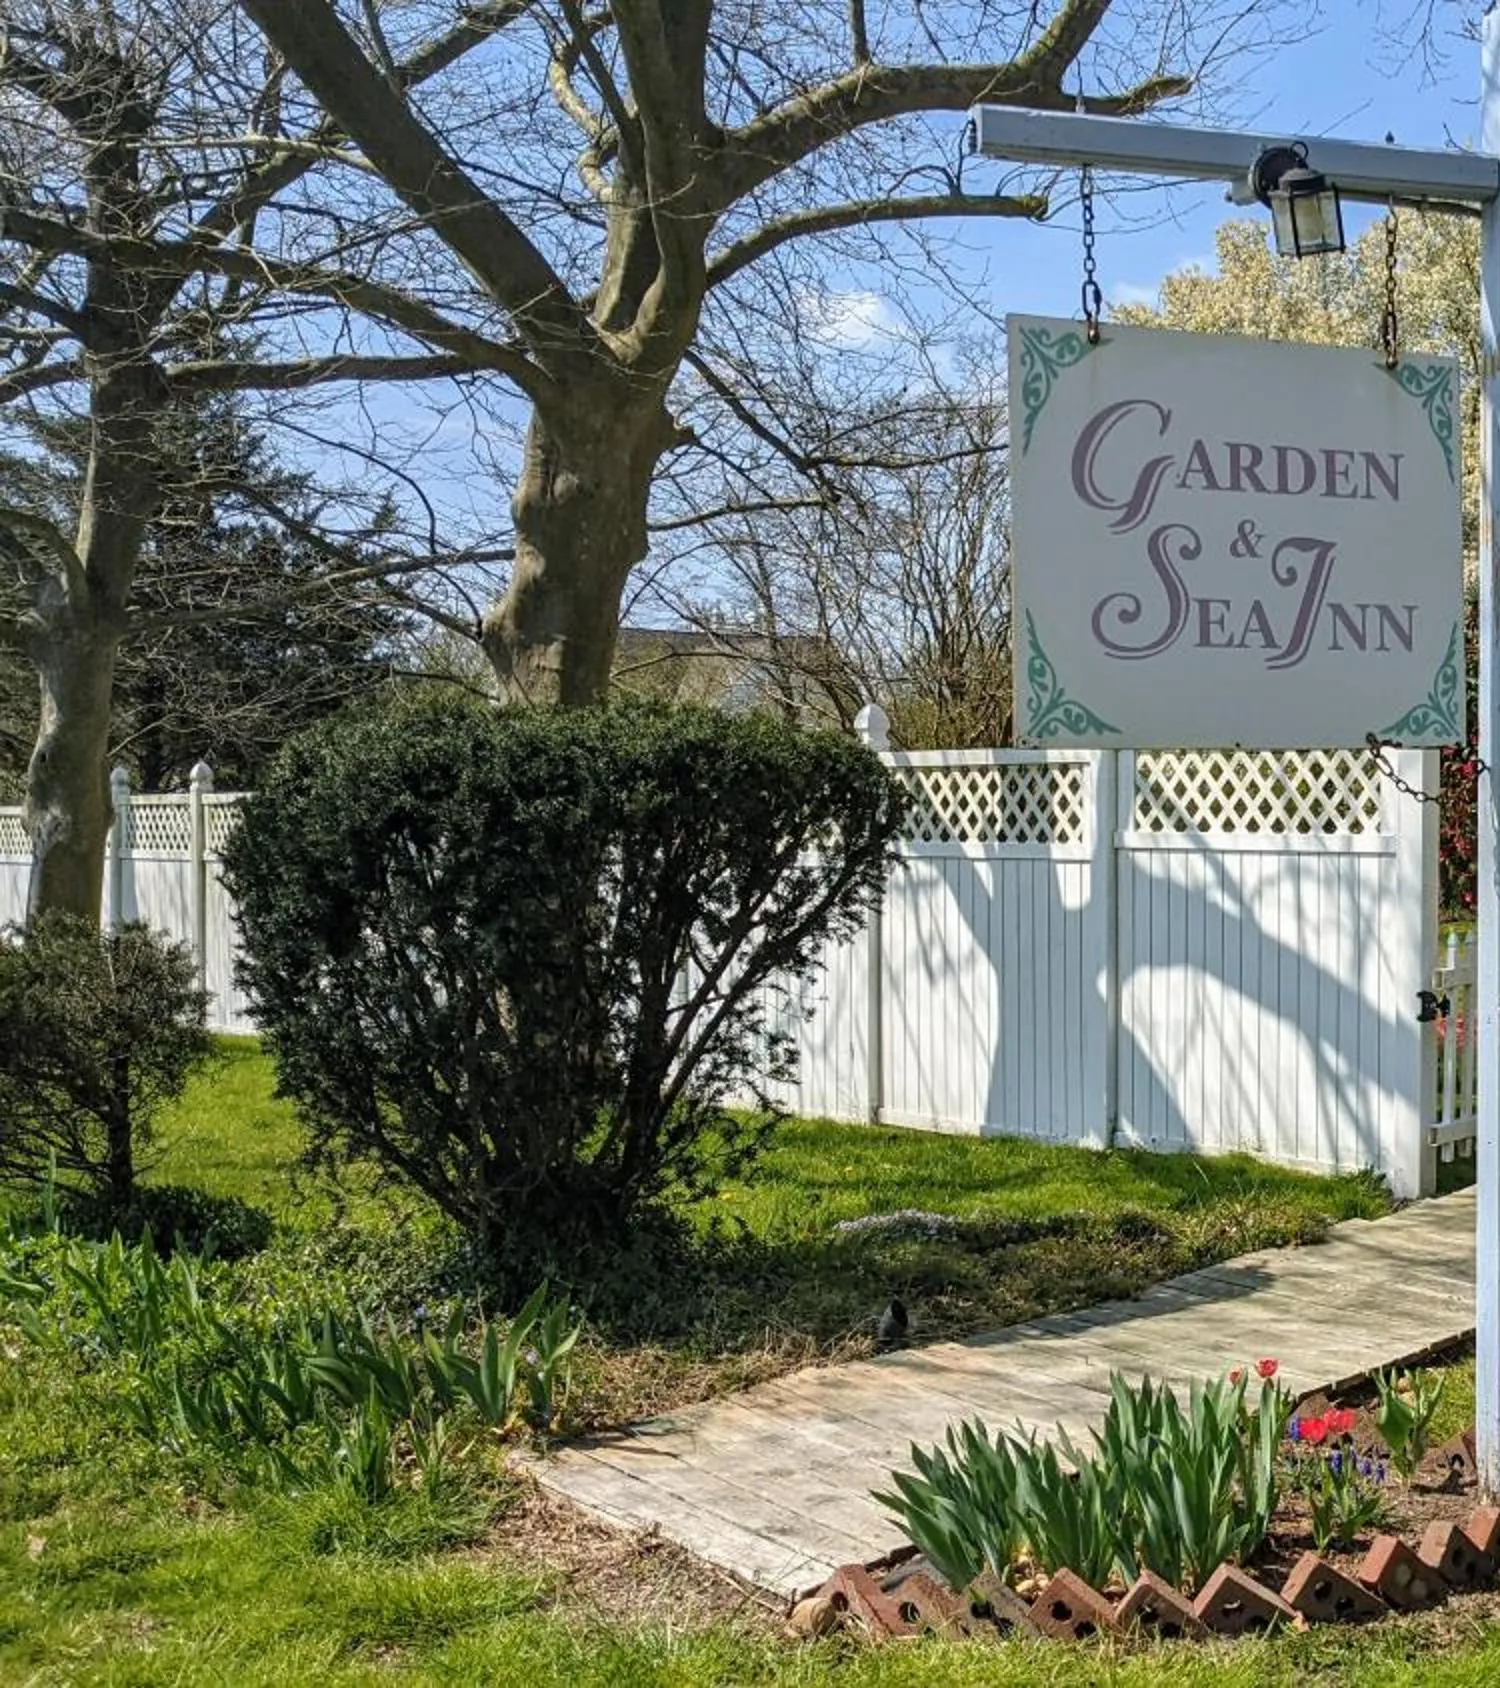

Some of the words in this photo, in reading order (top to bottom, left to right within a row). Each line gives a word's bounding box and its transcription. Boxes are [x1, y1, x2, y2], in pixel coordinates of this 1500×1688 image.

[1072, 400, 1404, 534] GARDEN
[1091, 524, 1281, 660] SEA
[1265, 538, 1418, 670] INN
[1230, 520, 1267, 558] &
